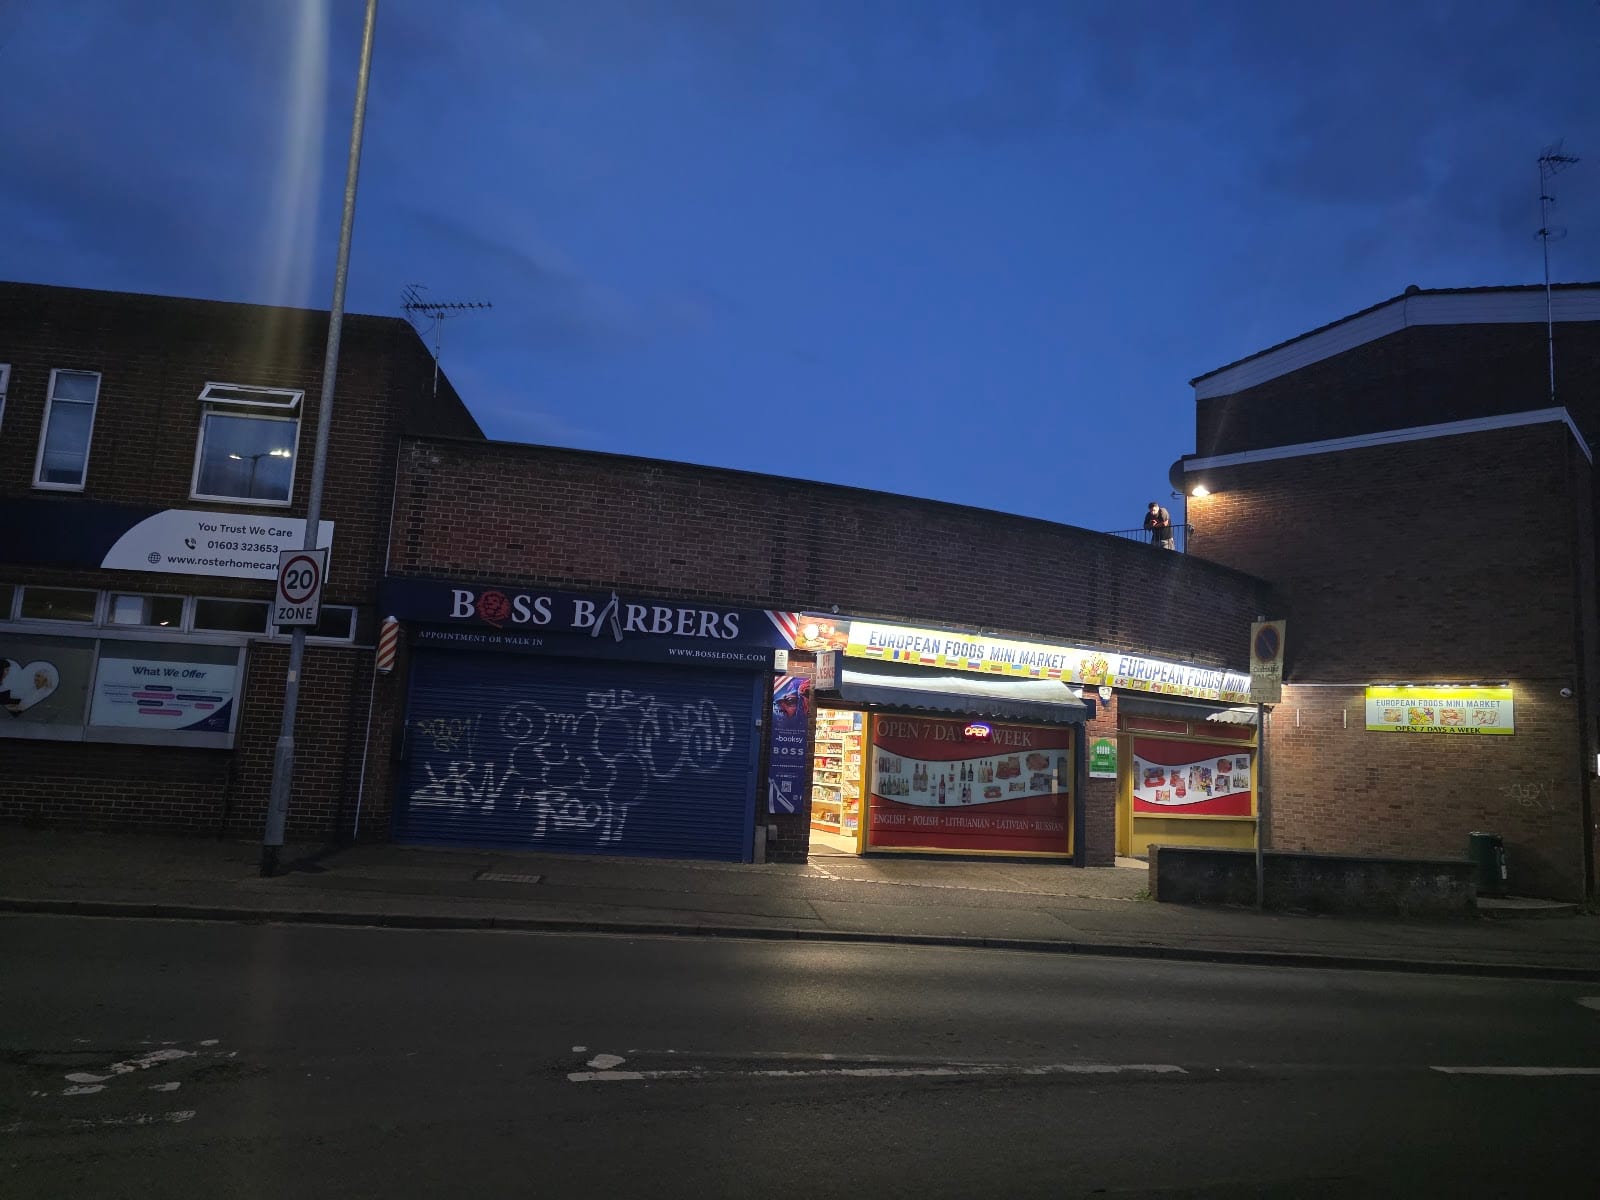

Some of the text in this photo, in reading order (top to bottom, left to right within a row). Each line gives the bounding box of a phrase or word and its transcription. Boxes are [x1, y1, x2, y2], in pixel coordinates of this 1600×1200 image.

[198, 522, 293, 538] You Trust We Care
[207, 540, 278, 553] 01603 323653
[286, 569, 313, 590] 20
[278, 607, 313, 620] ZONE
[418, 631, 487, 643] APPOINTMENT
[505, 637, 529, 645] WALK
[532, 639, 544, 647] IN
[669, 648, 766, 662] WWW.BOSSLEONE.COM
[869, 630, 1065, 669] EUROPEAN FOODS MINI MARKET
[132, 666, 207, 679] What We Offer
[1118, 657, 1184, 684] EUROPEAN
[1186, 669, 1221, 690] FOODS
[1225, 677, 1246, 693] MINI
[1376, 699, 1416, 707] EUROPEAN
[1466, 700, 1501, 708] MARKET
[877, 720, 920, 738] OPEN
[923, 724, 930, 739] 7
[991, 729, 1032, 746] WEEK
[964, 726, 988, 737] OPEN
[773, 747, 804, 756] BOSS
[873, 814, 906, 825] ENGLISH
[913, 816, 938, 826] POLISH
[945, 817, 990, 829] LITHUANIAN
